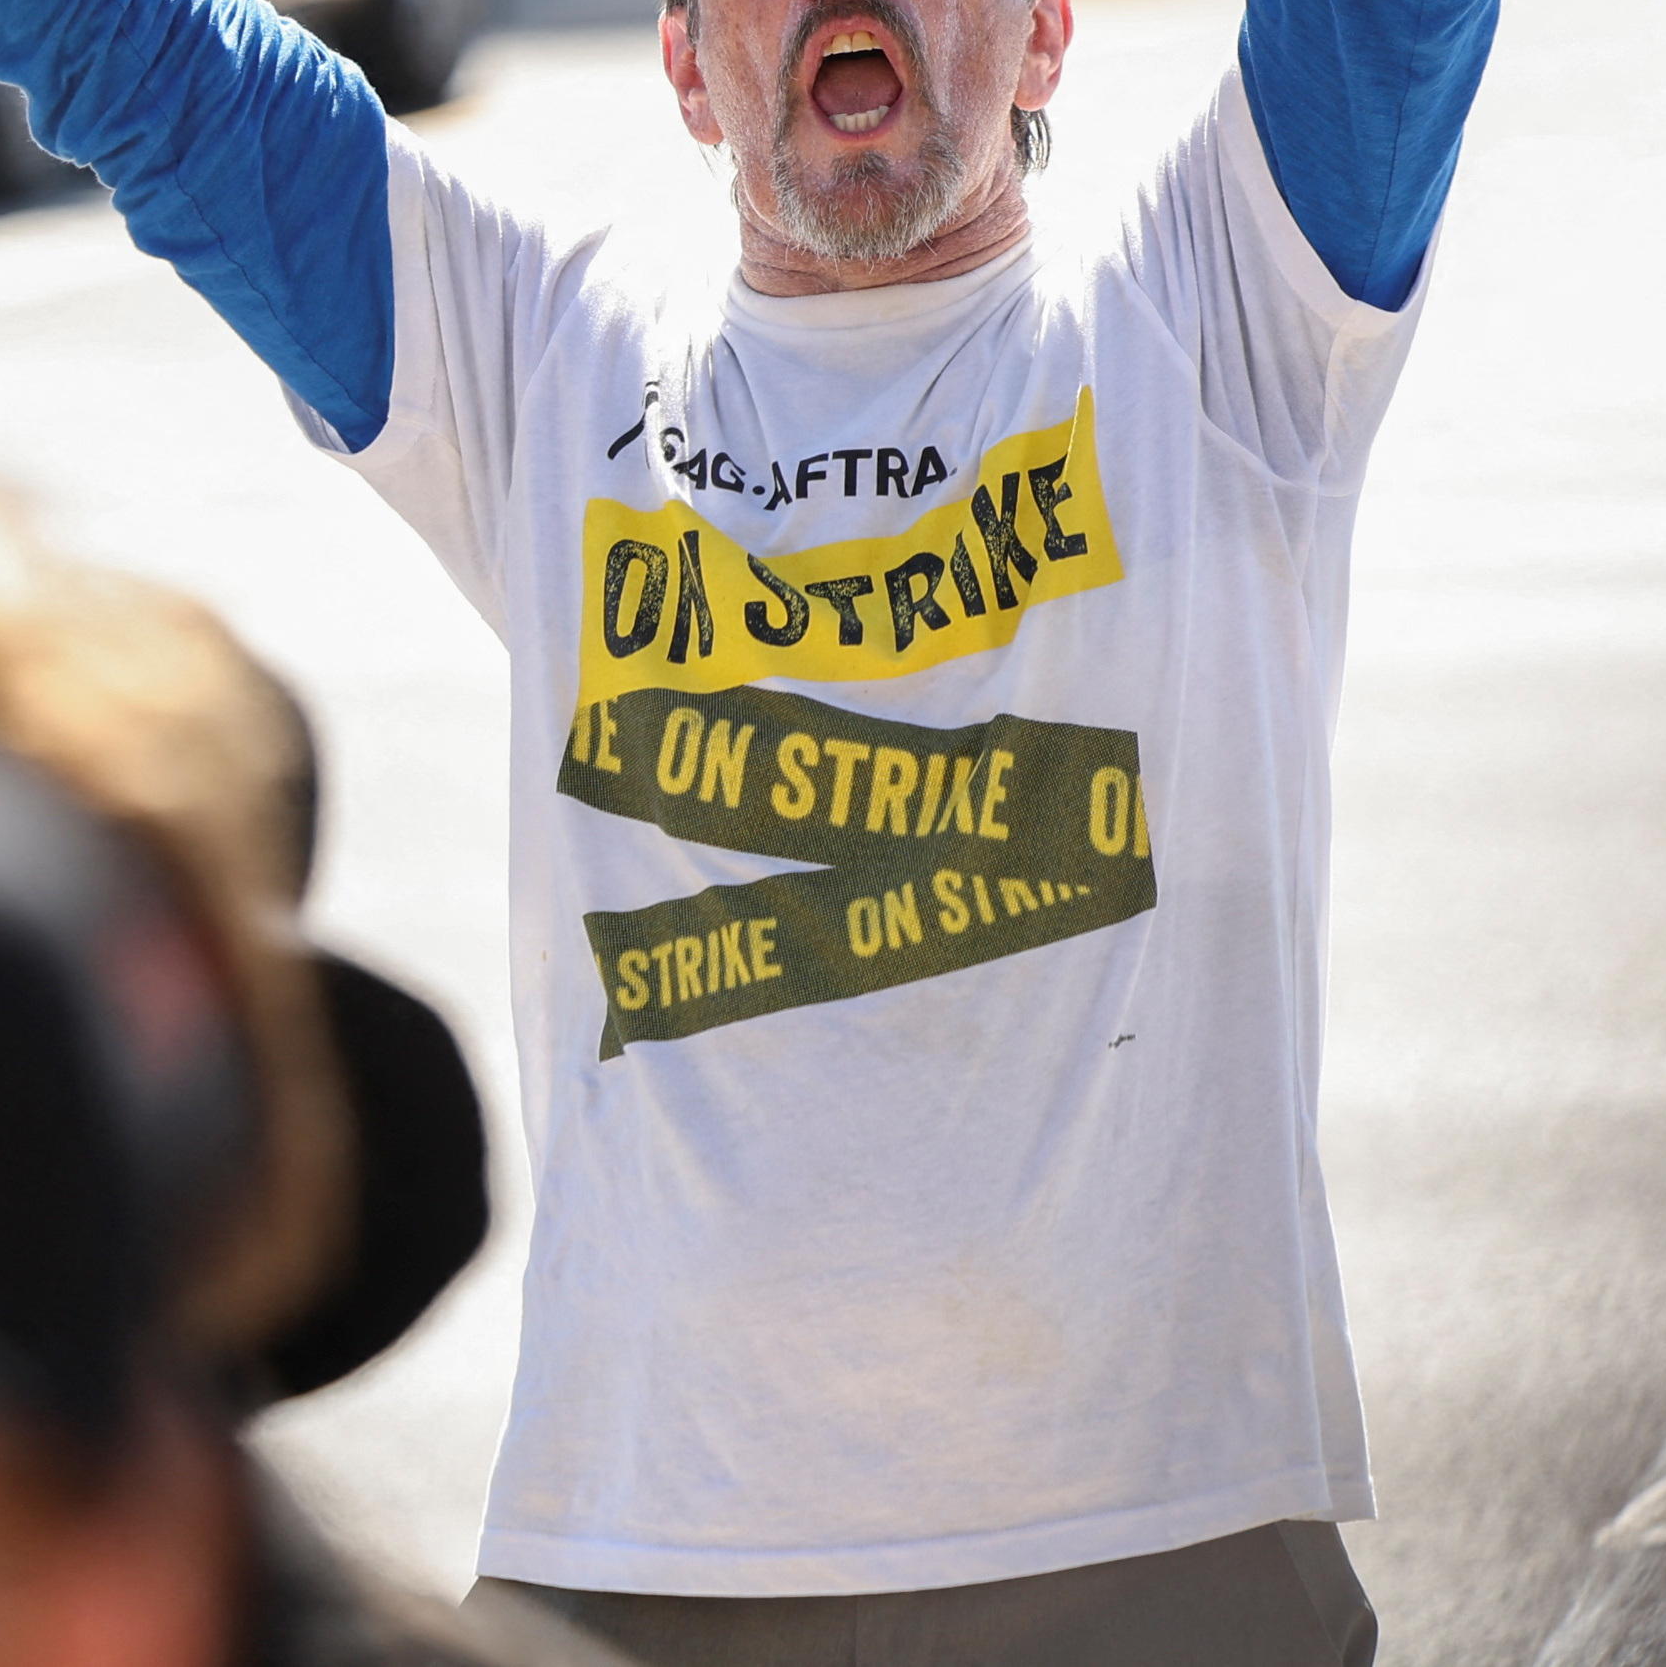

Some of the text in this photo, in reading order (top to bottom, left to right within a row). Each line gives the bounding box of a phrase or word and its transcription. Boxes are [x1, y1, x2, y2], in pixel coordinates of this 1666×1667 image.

[603, 452, 1088, 664] ON STRIKE
[656, 706, 755, 809] ON
[771, 732, 1015, 841] STRIKE
[616, 917, 783, 1011] STRIKE
[846, 881, 923, 957] ON
